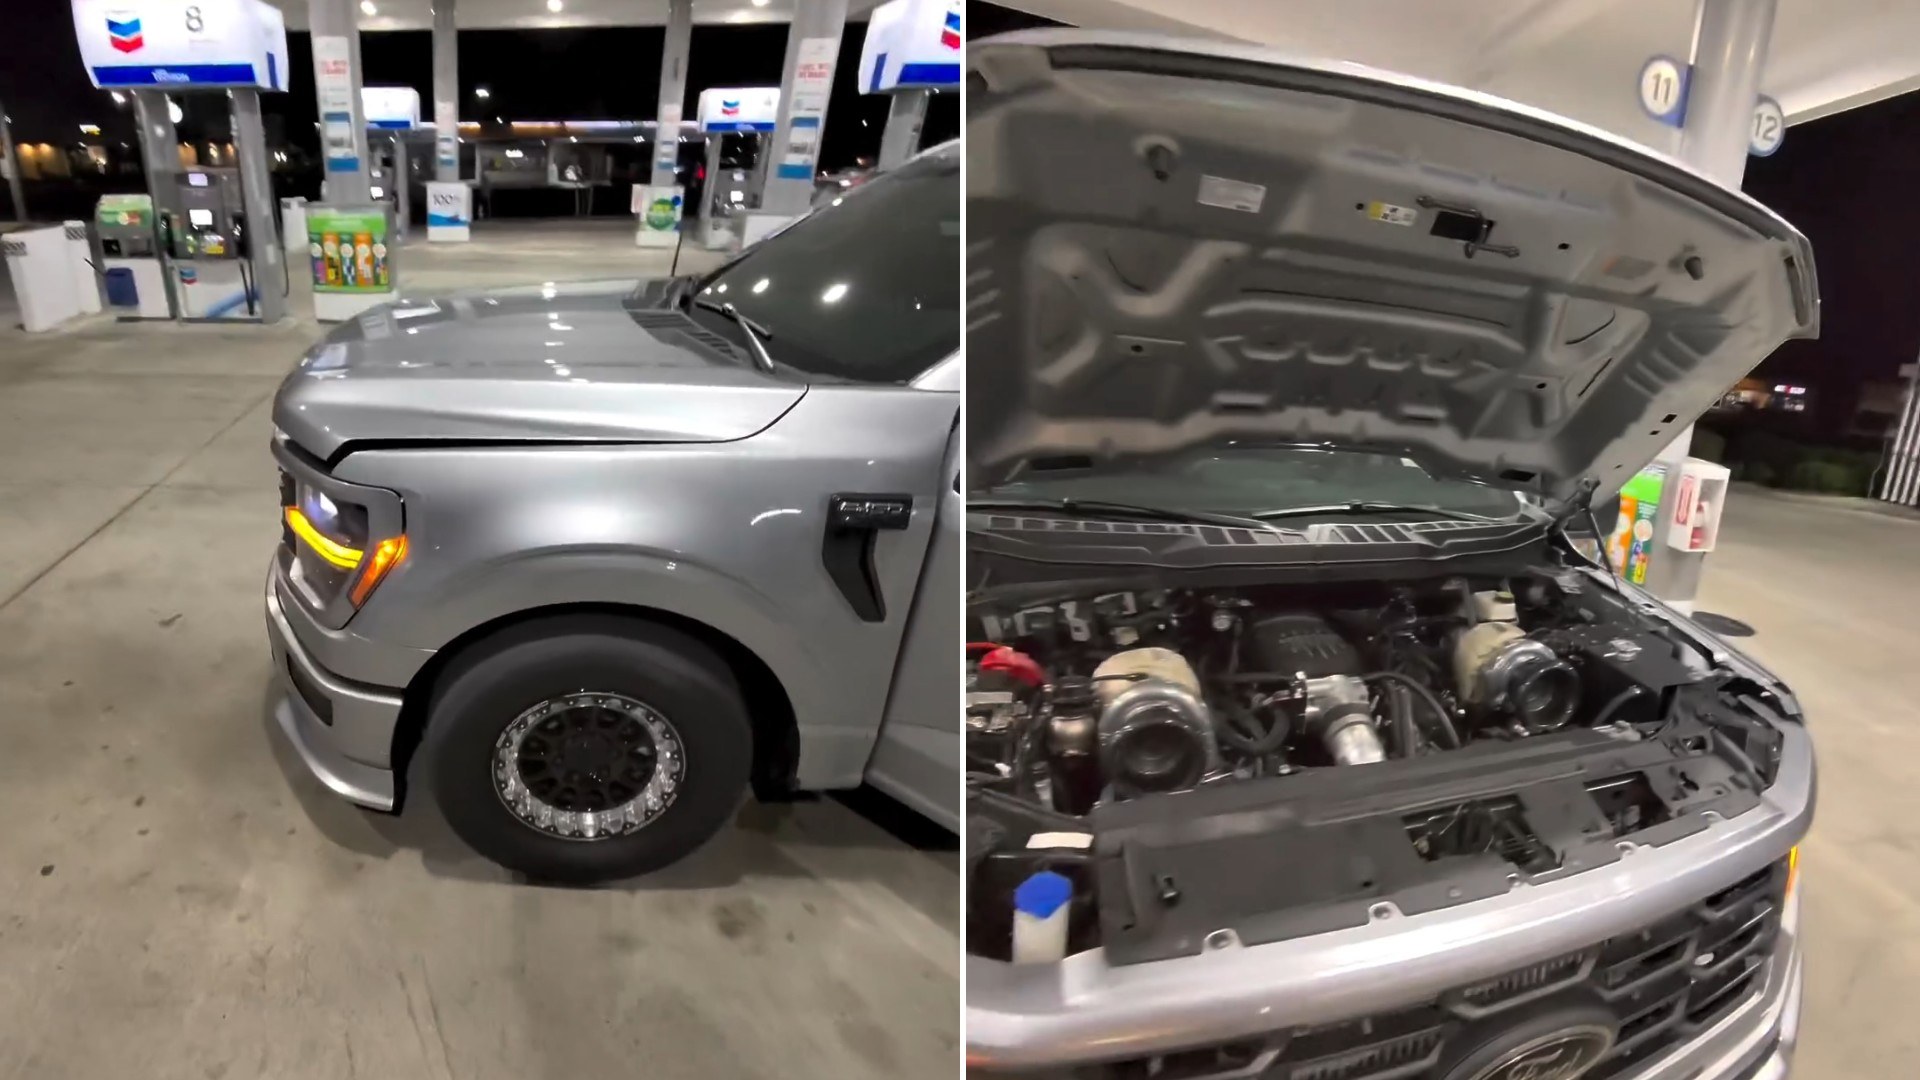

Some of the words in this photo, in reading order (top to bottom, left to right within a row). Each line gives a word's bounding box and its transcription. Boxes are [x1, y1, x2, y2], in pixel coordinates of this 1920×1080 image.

[185, 5, 204, 33] 8
[1652, 72, 1672, 106] 11
[1754, 112, 1778, 141] 12
